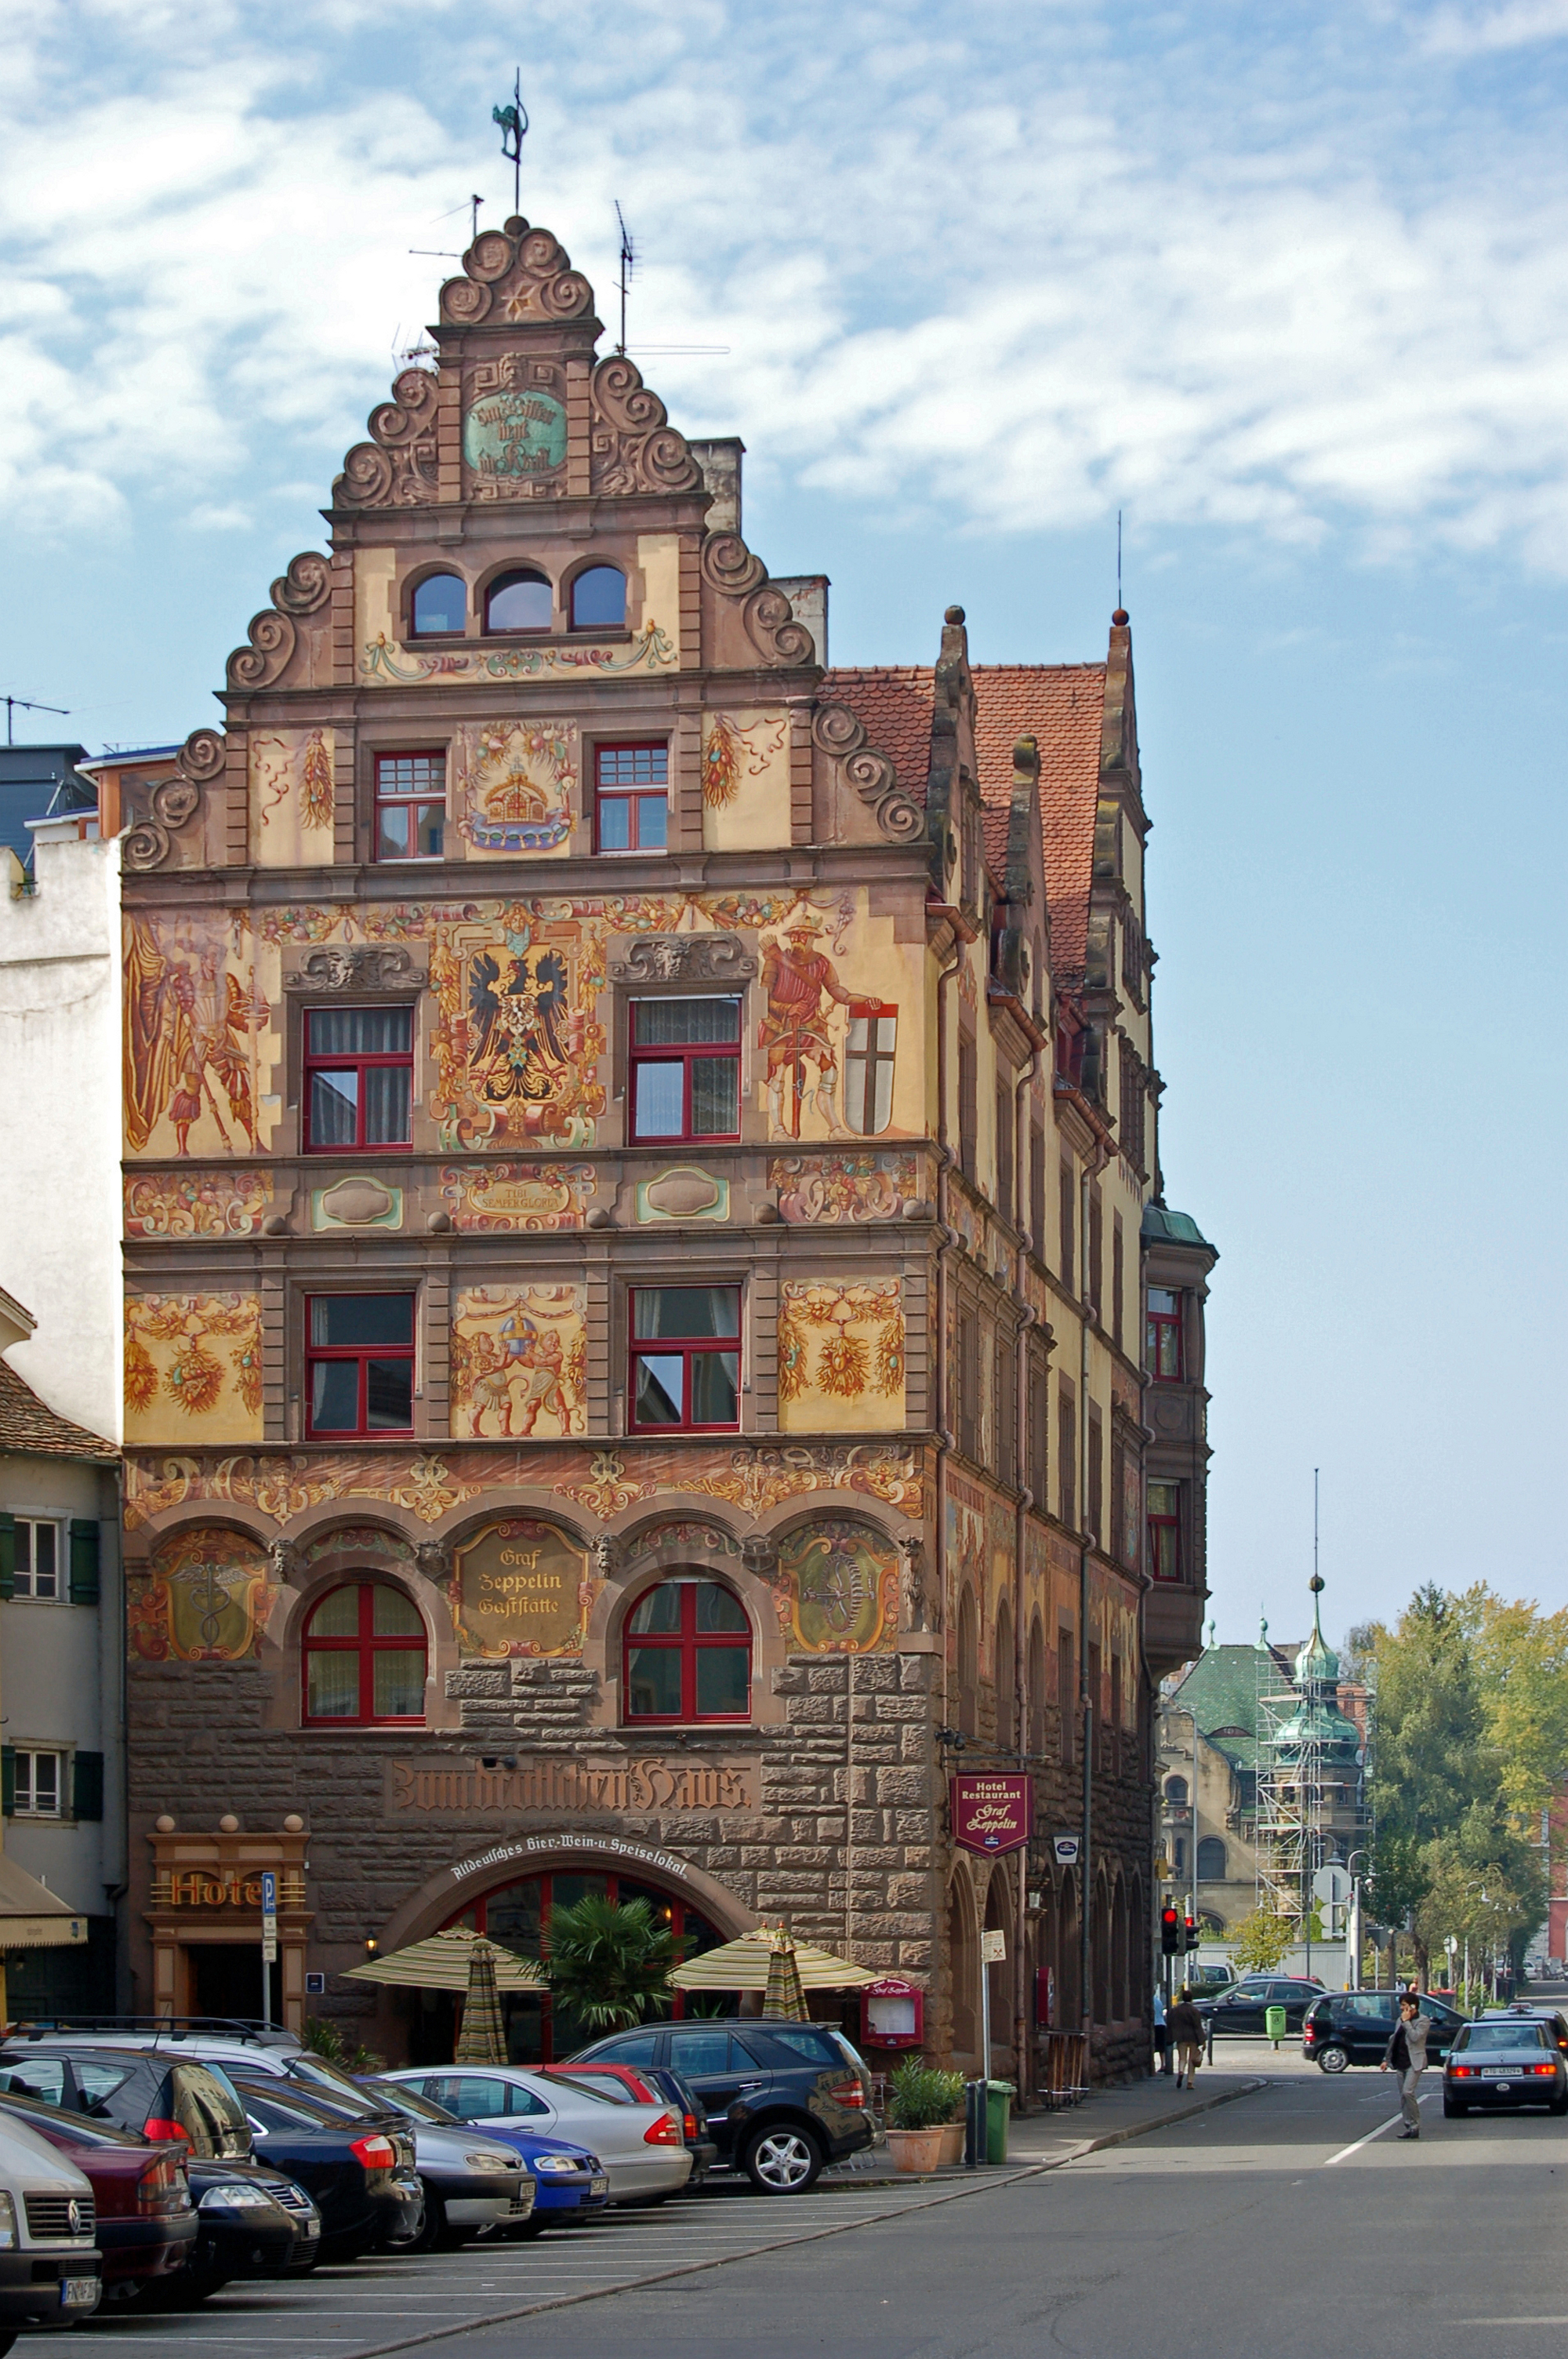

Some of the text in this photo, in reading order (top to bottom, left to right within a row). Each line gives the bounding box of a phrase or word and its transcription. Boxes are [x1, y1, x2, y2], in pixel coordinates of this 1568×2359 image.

[506, 1189, 527, 1198] TIBI
[482, 1197, 559, 1209] SEMPER GLORIA
[499, 1549, 542, 1569] Graf
[478, 1573, 561, 1593] Zeppelin
[394, 1760, 470, 1808] Zum
[976, 1781, 1006, 1790] Hotel
[962, 1790, 1021, 1799] Restaurant
[976, 1805, 1011, 1819] Graf
[966, 1818, 1017, 1833] Zeppelin
